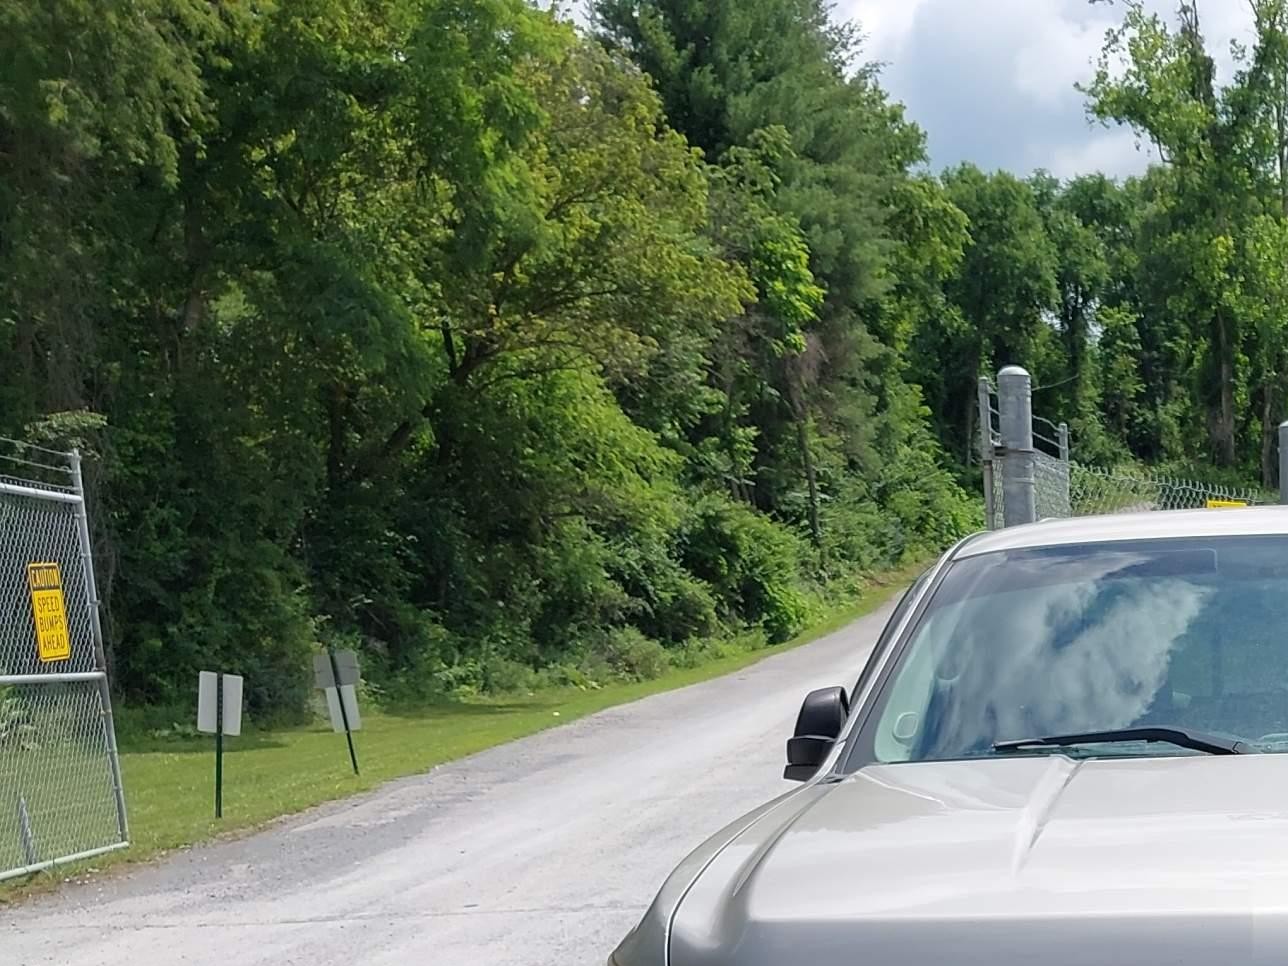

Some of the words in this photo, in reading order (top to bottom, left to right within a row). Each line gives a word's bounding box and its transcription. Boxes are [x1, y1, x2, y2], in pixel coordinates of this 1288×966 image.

[32, 568, 59, 587] CAUTION
[38, 596, 60, 613] SPEED
[39, 615, 64, 632] BUMPS
[43, 633, 65, 651] AHEAD
